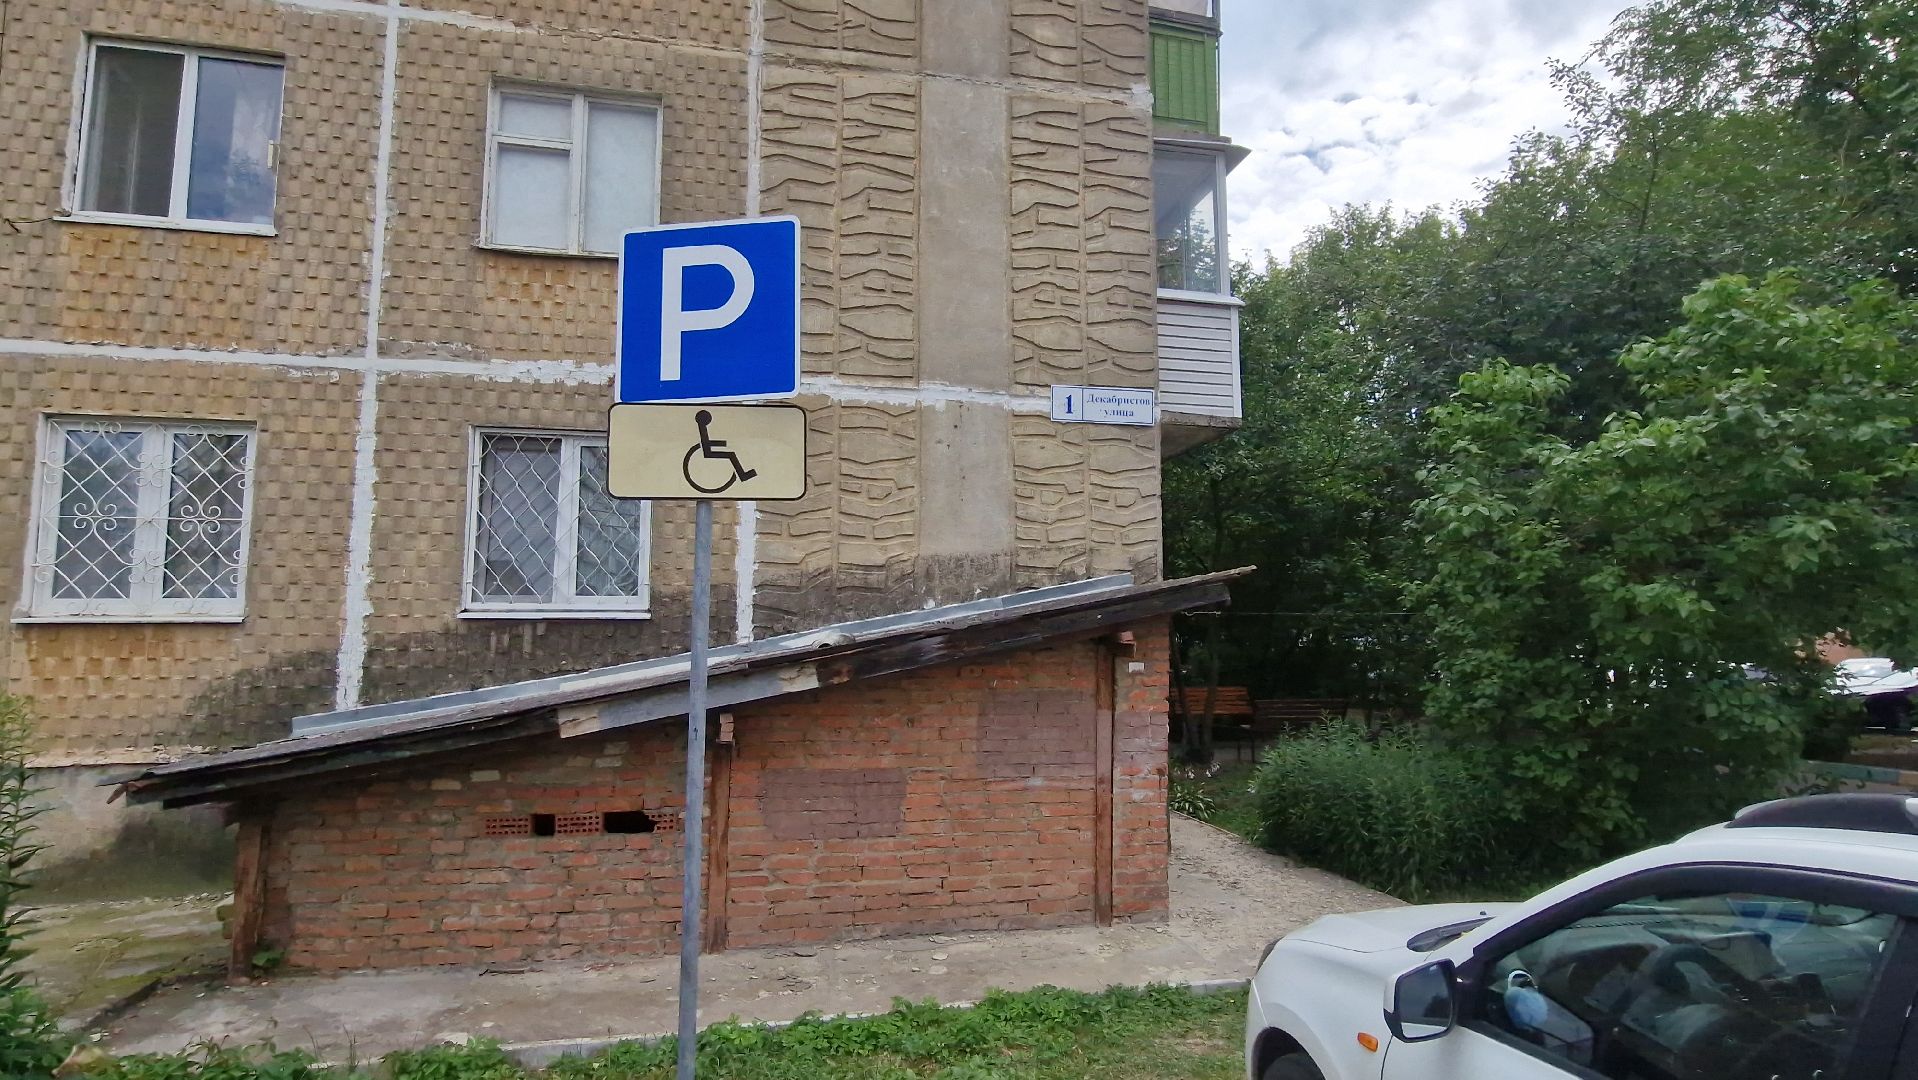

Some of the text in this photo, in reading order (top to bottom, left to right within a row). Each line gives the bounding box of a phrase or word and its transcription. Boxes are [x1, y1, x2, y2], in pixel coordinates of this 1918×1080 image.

[660, 244, 755, 381] P
[1065, 394, 1074, 414] 1
[1086, 393, 1151, 406] Декабристов
[1103, 408, 1134, 418] улица
